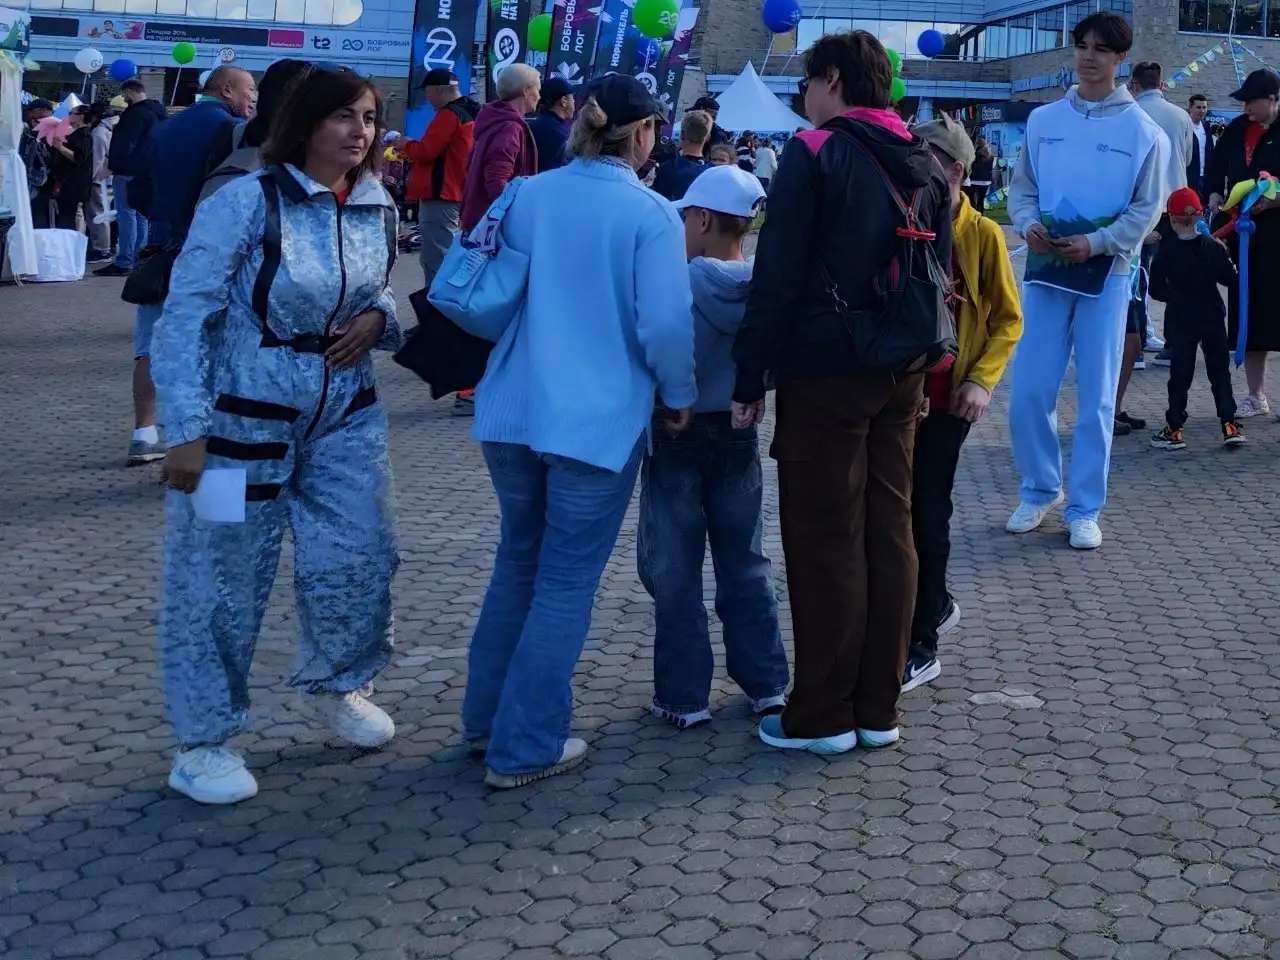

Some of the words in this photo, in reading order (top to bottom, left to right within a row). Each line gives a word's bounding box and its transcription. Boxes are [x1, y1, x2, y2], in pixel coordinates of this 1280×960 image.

[500, 0, 510, 20] ЛЕТ
[508, 5, 518, 21] НА
[367, 39, 410, 47] БОБРОВЫЙ
[574, 29, 586, 54] ЛОГ
[610, 8, 629, 67] НОРНИКЕЛЬ
[666, 69, 676, 87] ЛОГ
